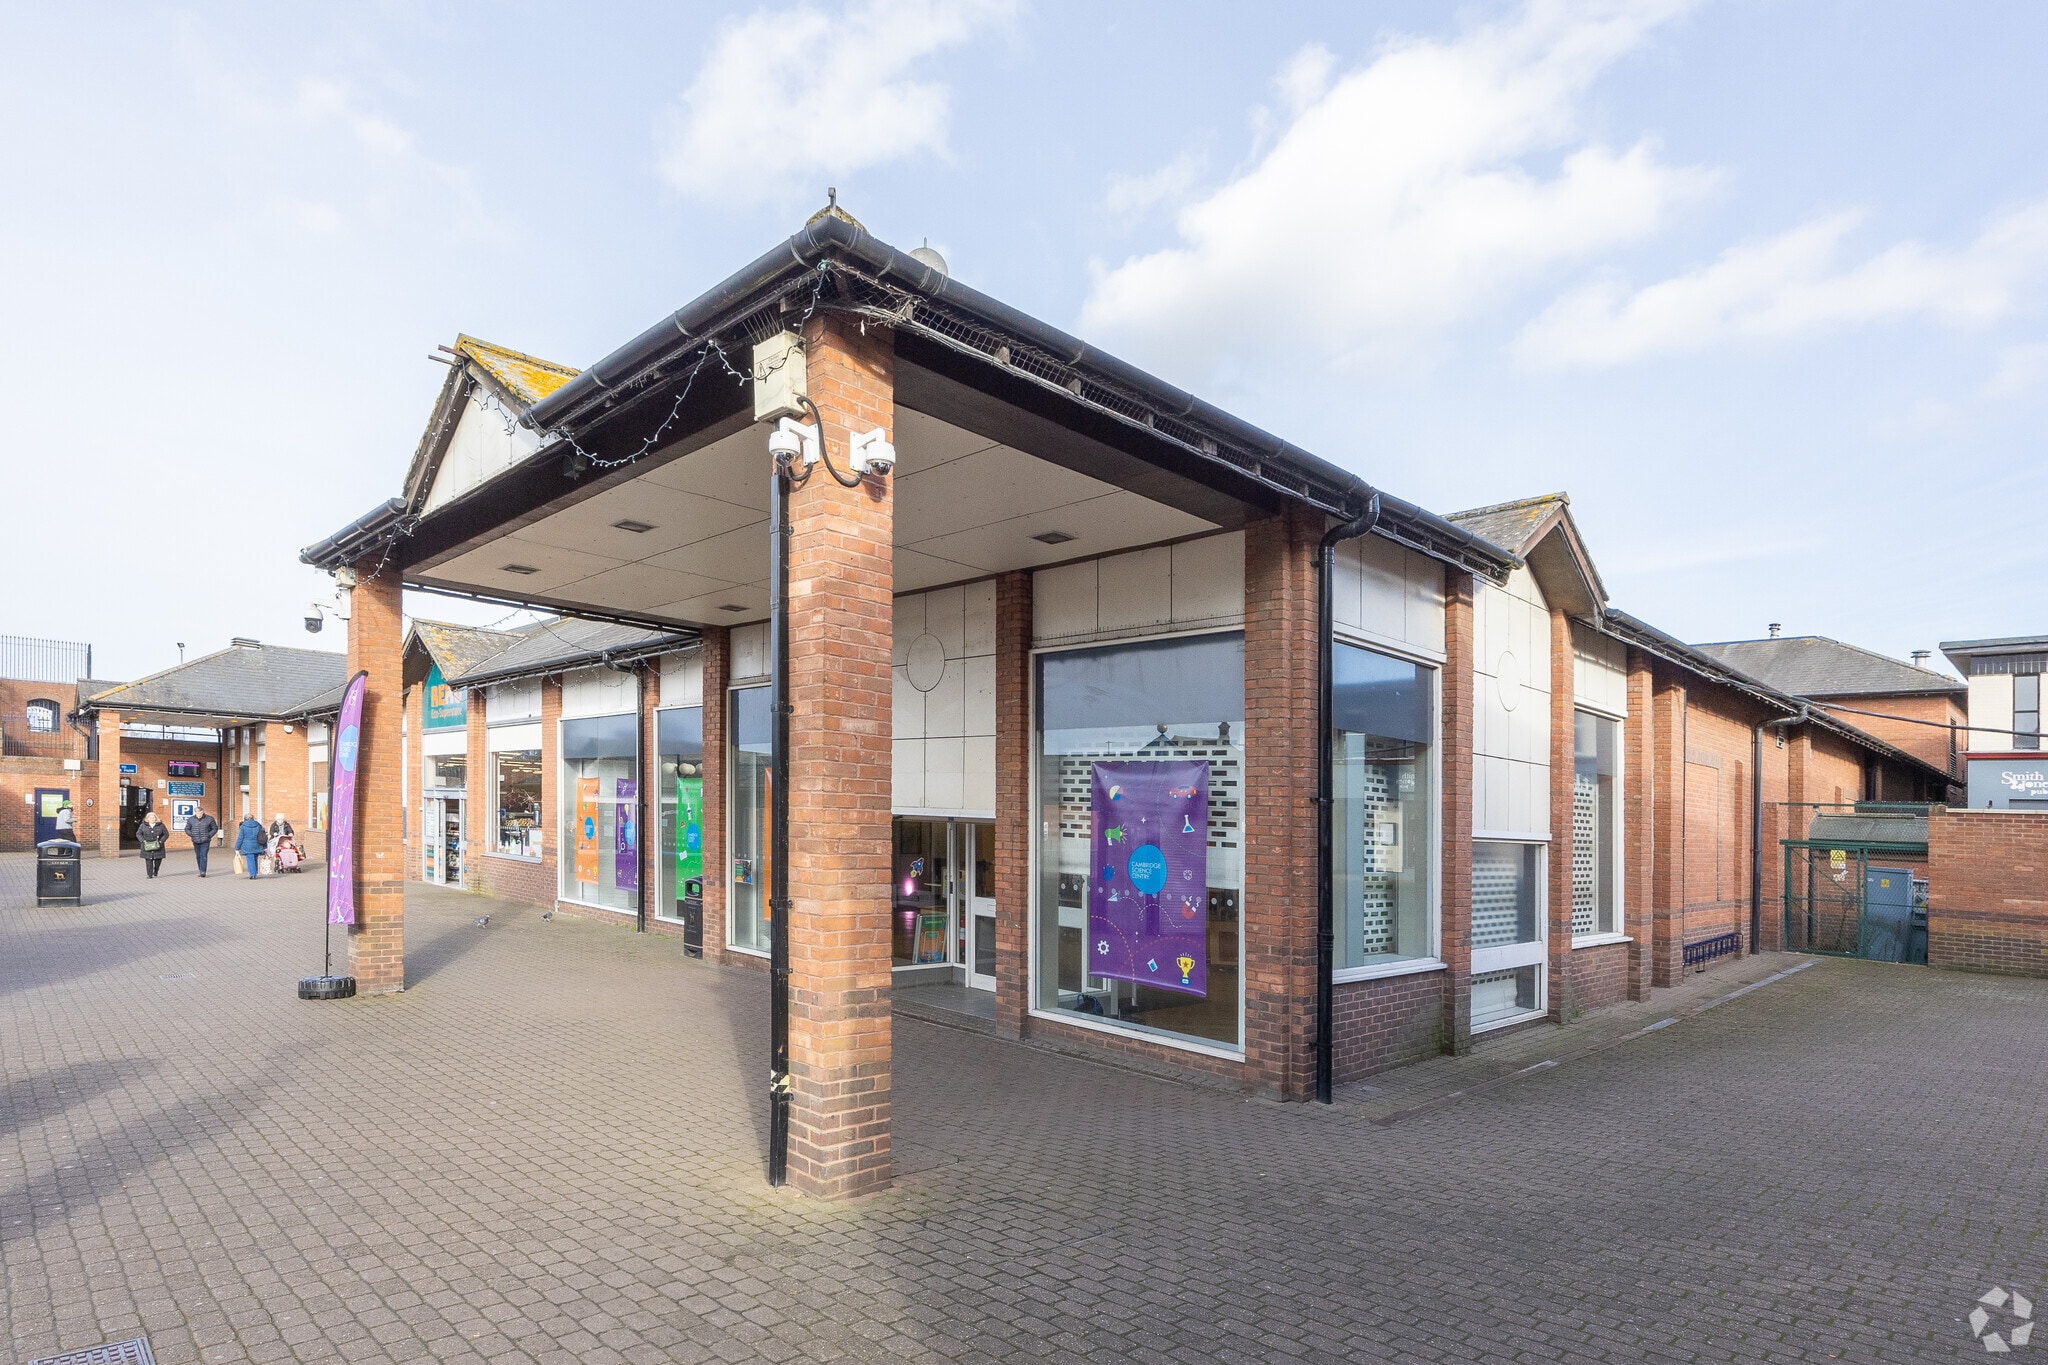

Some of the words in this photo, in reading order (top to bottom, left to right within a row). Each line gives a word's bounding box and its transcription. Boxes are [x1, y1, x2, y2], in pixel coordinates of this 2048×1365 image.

[2001, 771, 2044, 785] Smith
[181, 806, 191, 815] P
[1131, 861, 1161, 870] CAMBRIDGE
[1131, 867, 1152, 875] SCIENCE
